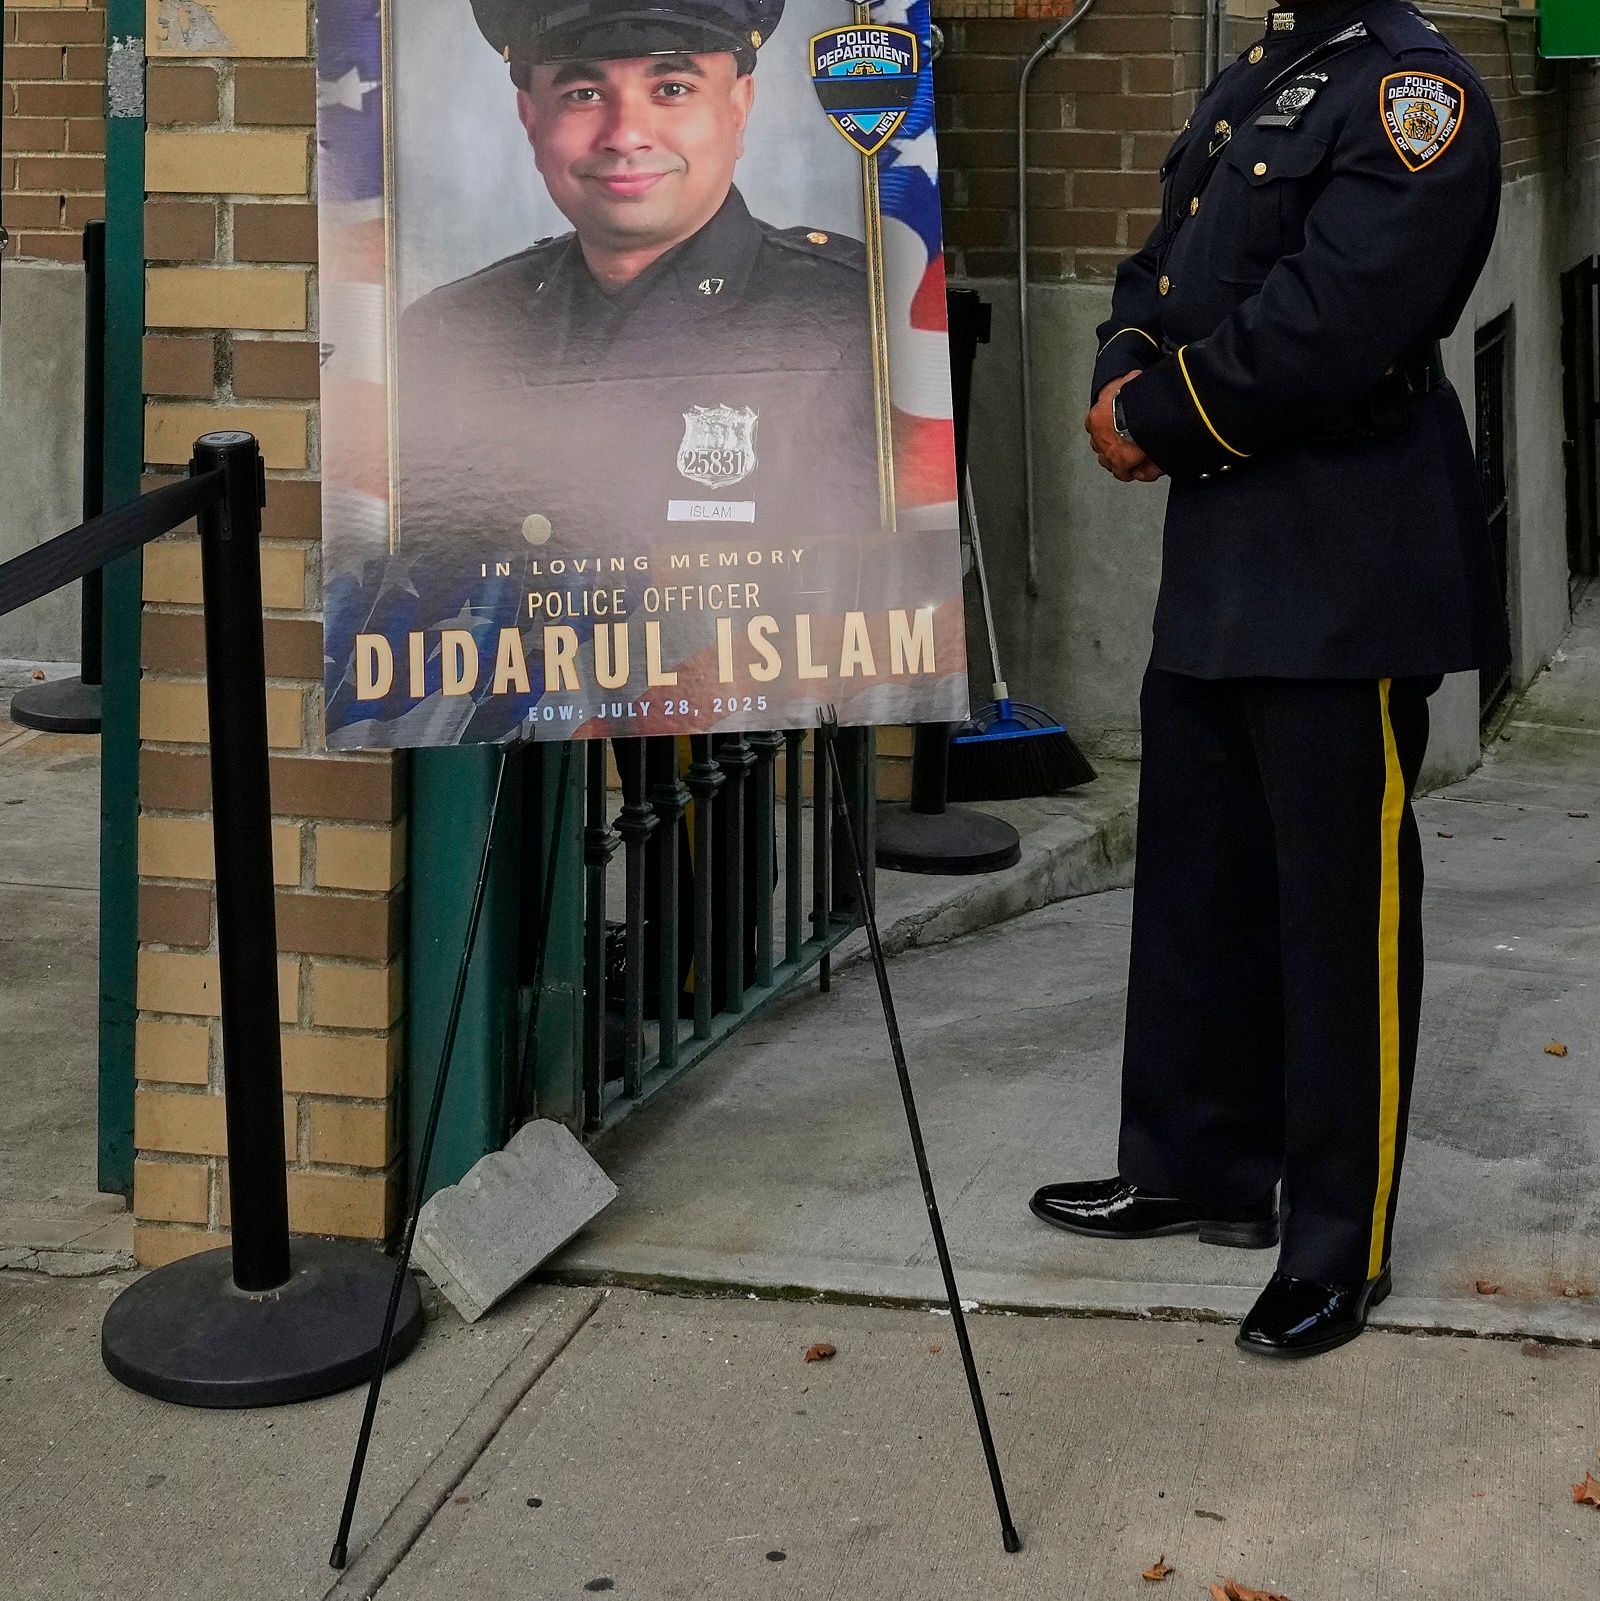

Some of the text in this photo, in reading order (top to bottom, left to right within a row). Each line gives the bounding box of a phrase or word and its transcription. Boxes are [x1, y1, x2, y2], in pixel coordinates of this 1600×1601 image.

[836, 31, 890, 48] POLICE
[817, 45, 911, 71] DEPARTMENT
[1404, 76, 1444, 92] POLICE
[1388, 86, 1458, 109] DEPARTMENT
[839, 115, 857, 134] OF
[1385, 111, 1410, 151] CITY OF
[1420, 116, 1457, 161] NEW YORK
[698, 278, 725, 295] 47
[684, 449, 746, 476] 25831
[689, 505, 733, 519] ISLAM
[480, 548, 805, 578] IN LOVING MEMORY
[527, 582, 761, 619] POLICE OFFICER
[355, 606, 937, 701] DIDARUL ISLAM
[528, 695, 768, 722] EOW: JULY 28, 2025
